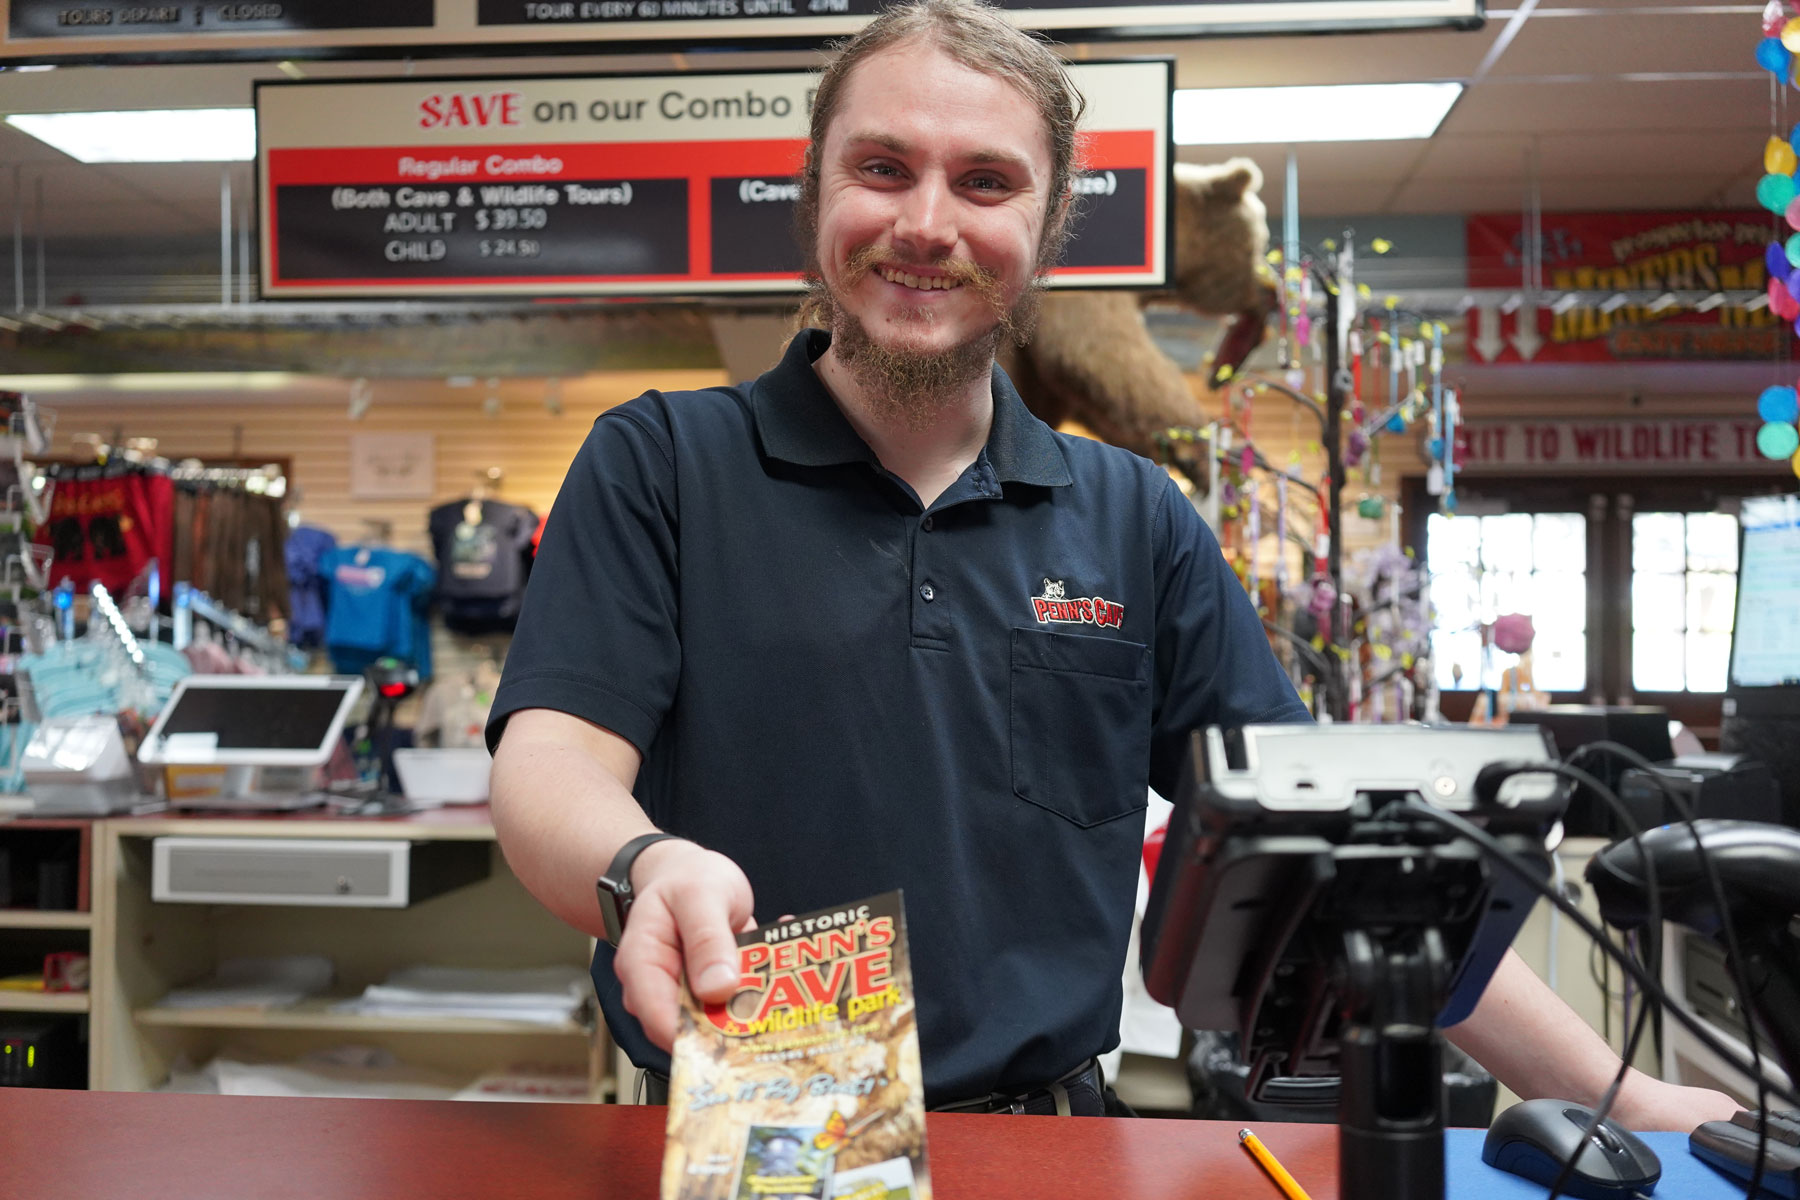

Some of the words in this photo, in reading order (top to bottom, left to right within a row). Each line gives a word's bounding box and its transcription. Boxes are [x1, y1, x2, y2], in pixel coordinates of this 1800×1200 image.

[525, 3, 575, 19] TOUR
[580, 1, 635, 18] EVERY
[662, 0, 739, 16] MINUTES
[743, 0, 796, 15] UNTIL
[419, 93, 522, 127] SAVE
[534, 99, 577, 123] on
[589, 97, 648, 121] our
[659, 90, 792, 121] Combo
[398, 157, 480, 181] Regular
[485, 154, 563, 175] Combo
[331, 187, 391, 210] (Both
[396, 187, 450, 208] Cave
[456, 187, 474, 207] &
[480, 184, 559, 206] Wildlife
[564, 182, 633, 206] Tours)
[384, 212, 457, 233] ADULT
[385, 239, 447, 262] CHILD
[1523, 426, 1559, 461] TO
[1571, 423, 1720, 461] WILDLIFE
[1032, 598, 1094, 623] PENN'S
[764, 905, 870, 943] HISTORIC
[739, 916, 895, 975] PENN'S
[703, 949, 892, 1036] CAVE
[746, 1000, 840, 1035] wildlife
[847, 983, 902, 1022] park
